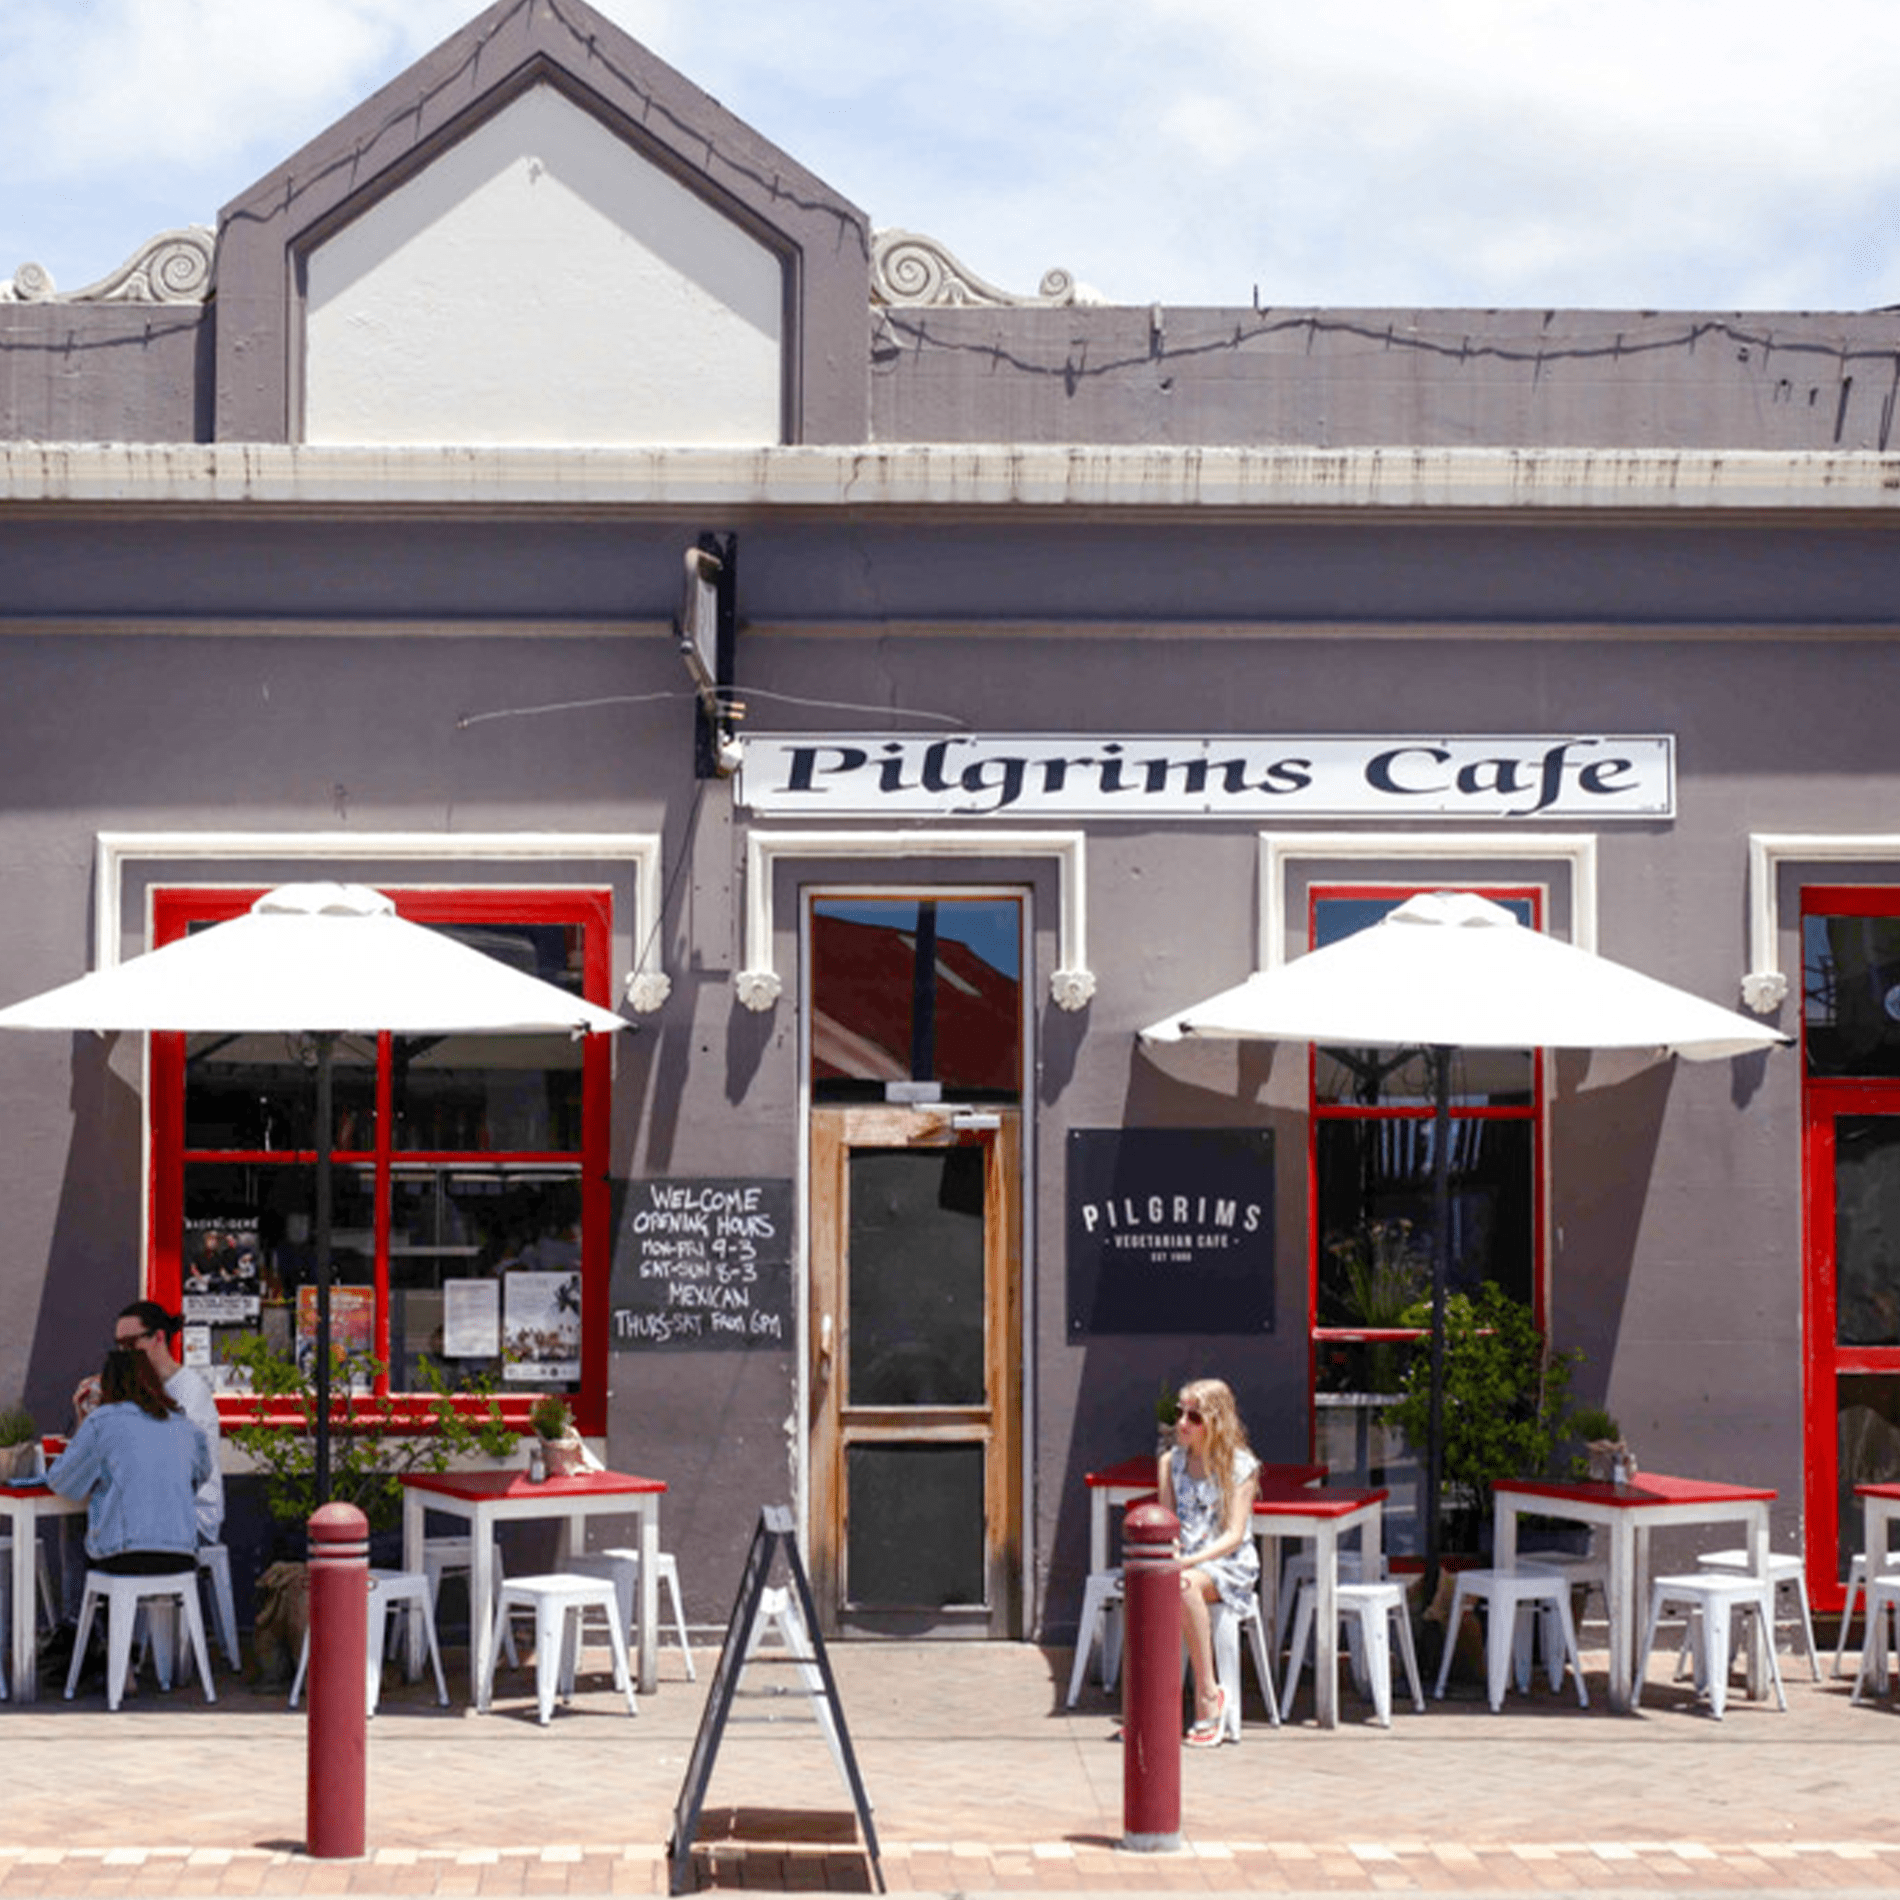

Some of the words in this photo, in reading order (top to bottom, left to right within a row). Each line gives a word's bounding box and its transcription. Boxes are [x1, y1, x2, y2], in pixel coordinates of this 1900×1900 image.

[772, 738, 1312, 814] Pilgrims
[1365, 739, 1640, 816] Cafe
[651, 1184, 762, 1213] WELCOME
[633, 1211, 709, 1238] OPENING
[716, 1214, 775, 1238] HOURS
[1082, 1195, 1261, 1233] PILGRIMS
[641, 1238, 705, 1258] MON-FRI
[1114, 1234, 1193, 1248] VEGETARIAN
[1196, 1234, 1228, 1248] CAFE
[639, 1260, 711, 1279] SAT-SUN
[669, 1281, 749, 1308] MEXICAN
[711, 1311, 746, 1334] FROM
[750, 1309, 782, 1339] 6PM
